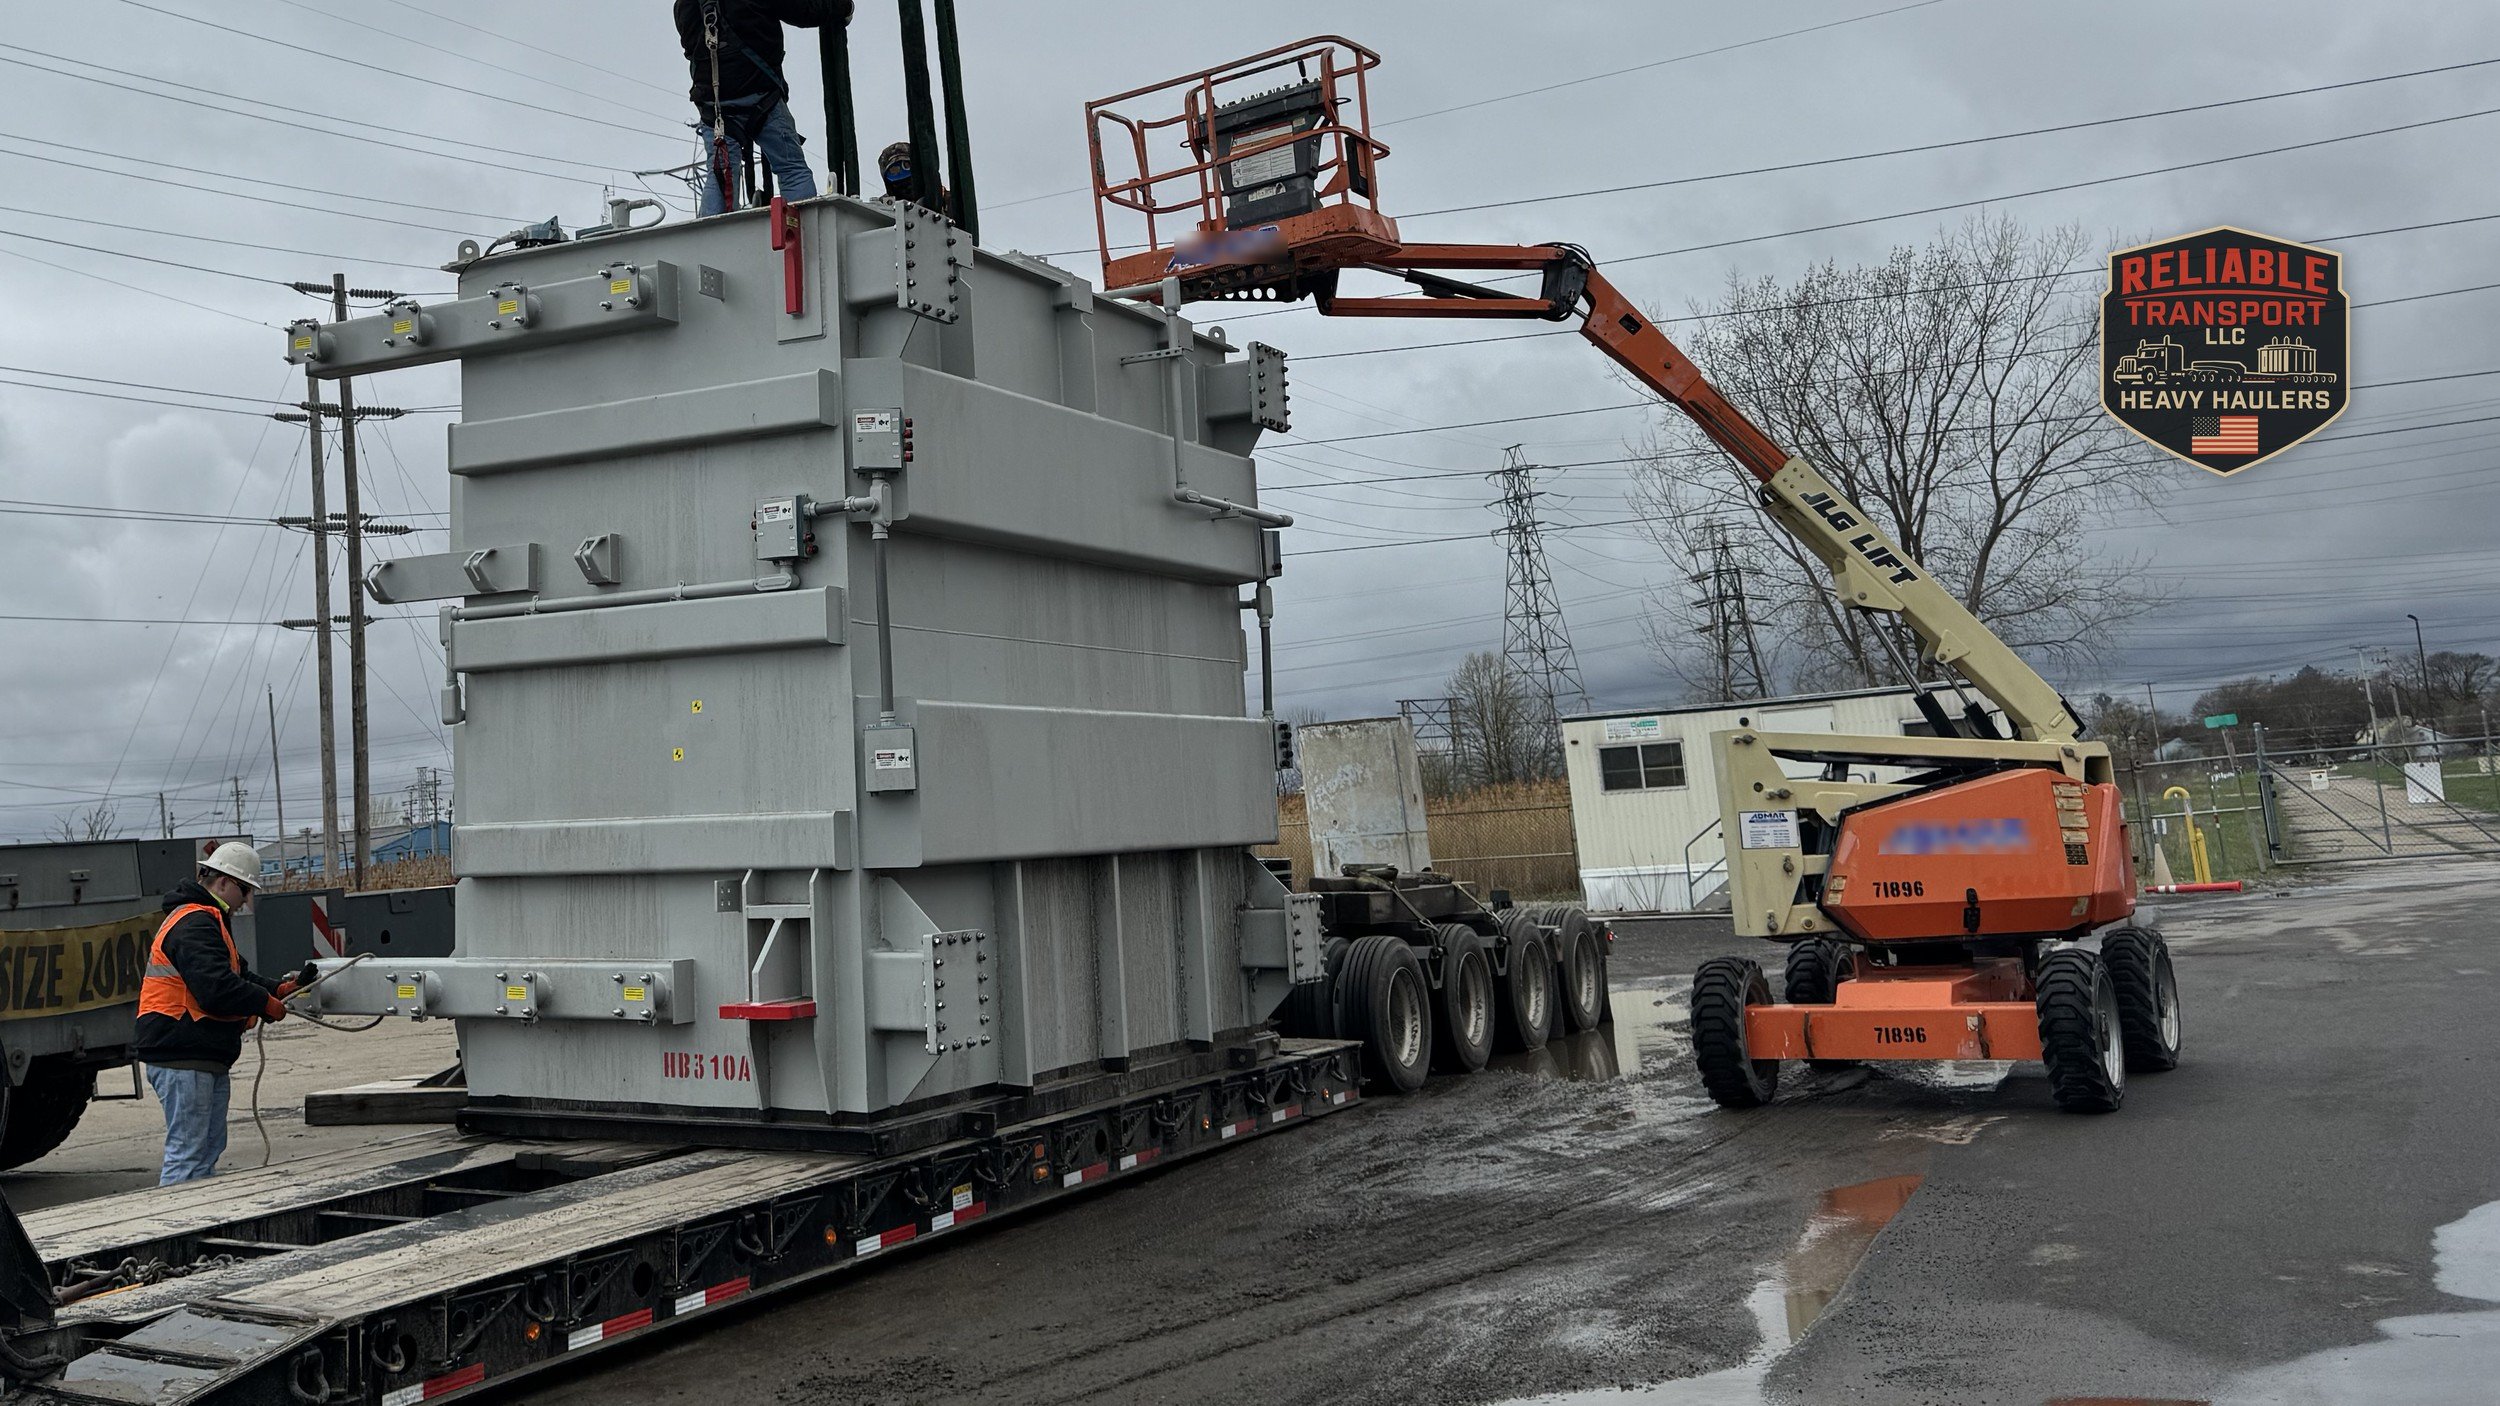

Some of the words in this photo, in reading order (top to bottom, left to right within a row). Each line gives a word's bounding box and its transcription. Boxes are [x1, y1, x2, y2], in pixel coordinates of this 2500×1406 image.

[1798, 491, 1860, 533] JLG
[1848, 533, 1919, 585] LIFT
[1872, 880, 1925, 898] 71896
[1873, 1026, 1927, 1044] 71896
[663, 1051, 751, 1082] HB310A
